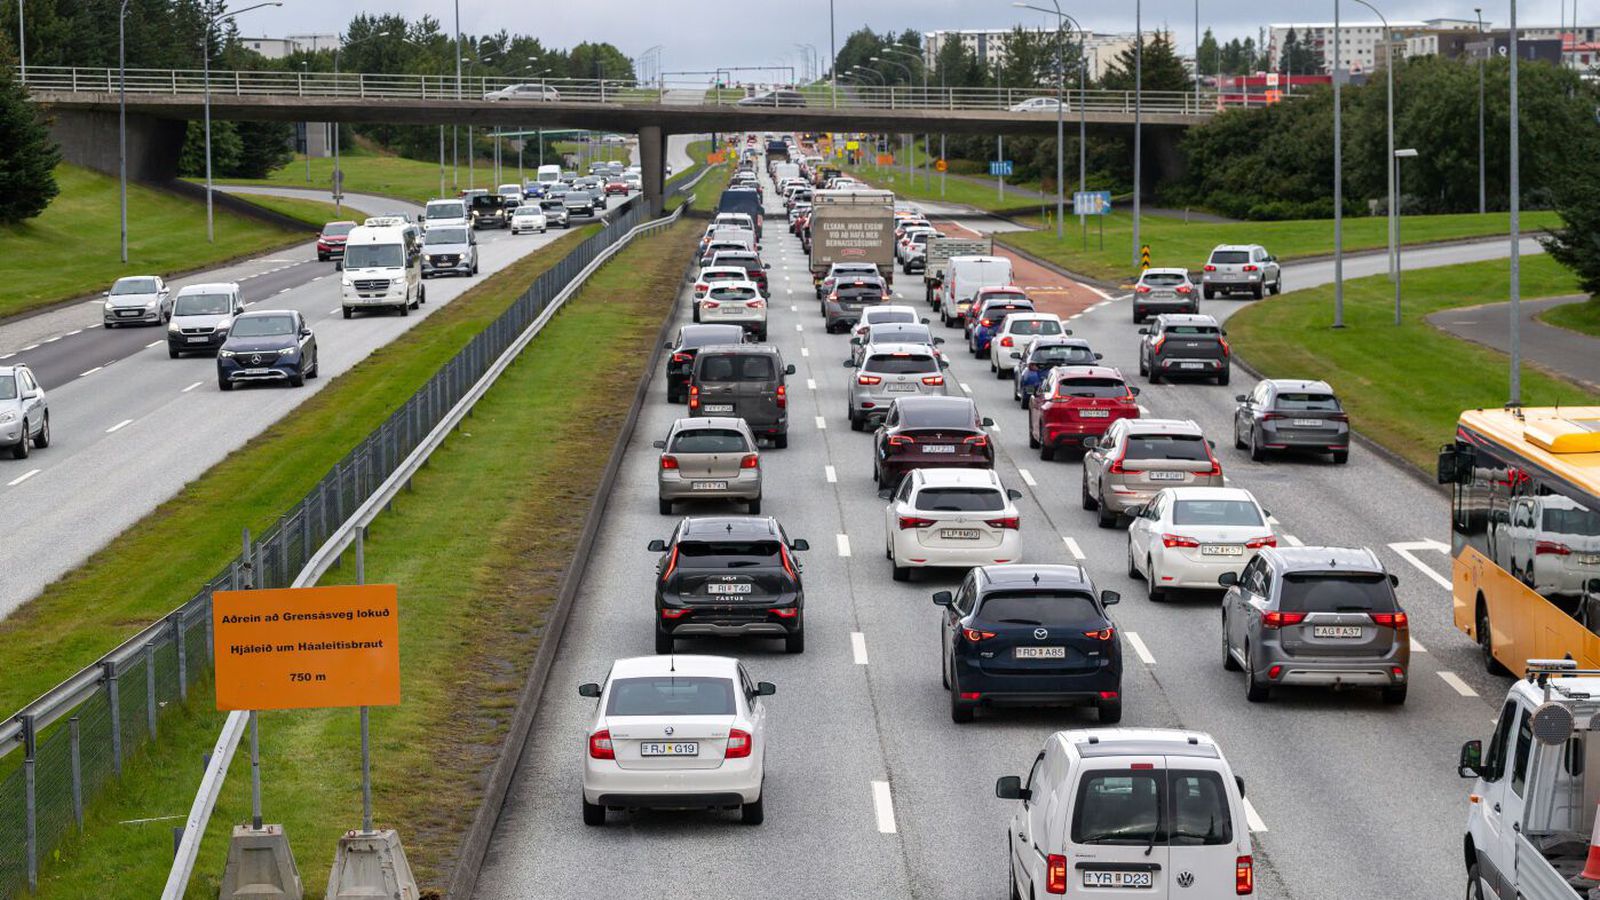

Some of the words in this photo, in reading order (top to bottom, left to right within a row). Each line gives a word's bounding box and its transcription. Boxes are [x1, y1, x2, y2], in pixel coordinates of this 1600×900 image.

[222, 613, 261, 624] Aðrein
[265, 613, 279, 622] að
[283, 610, 353, 622] Grensásveg
[357, 609, 390, 618] lokuð
[1321, 626, 1335, 635] AG
[1342, 626, 1359, 635] A37
[298, 640, 383, 651] Háaleitisbraut
[290, 672, 311, 681] 750
[315, 673, 326, 681] m
[650, 744, 665, 752] RJ
[674, 744, 694, 752] G19
[1094, 873, 1112, 883] YR
[1123, 874, 1149, 884] D23
